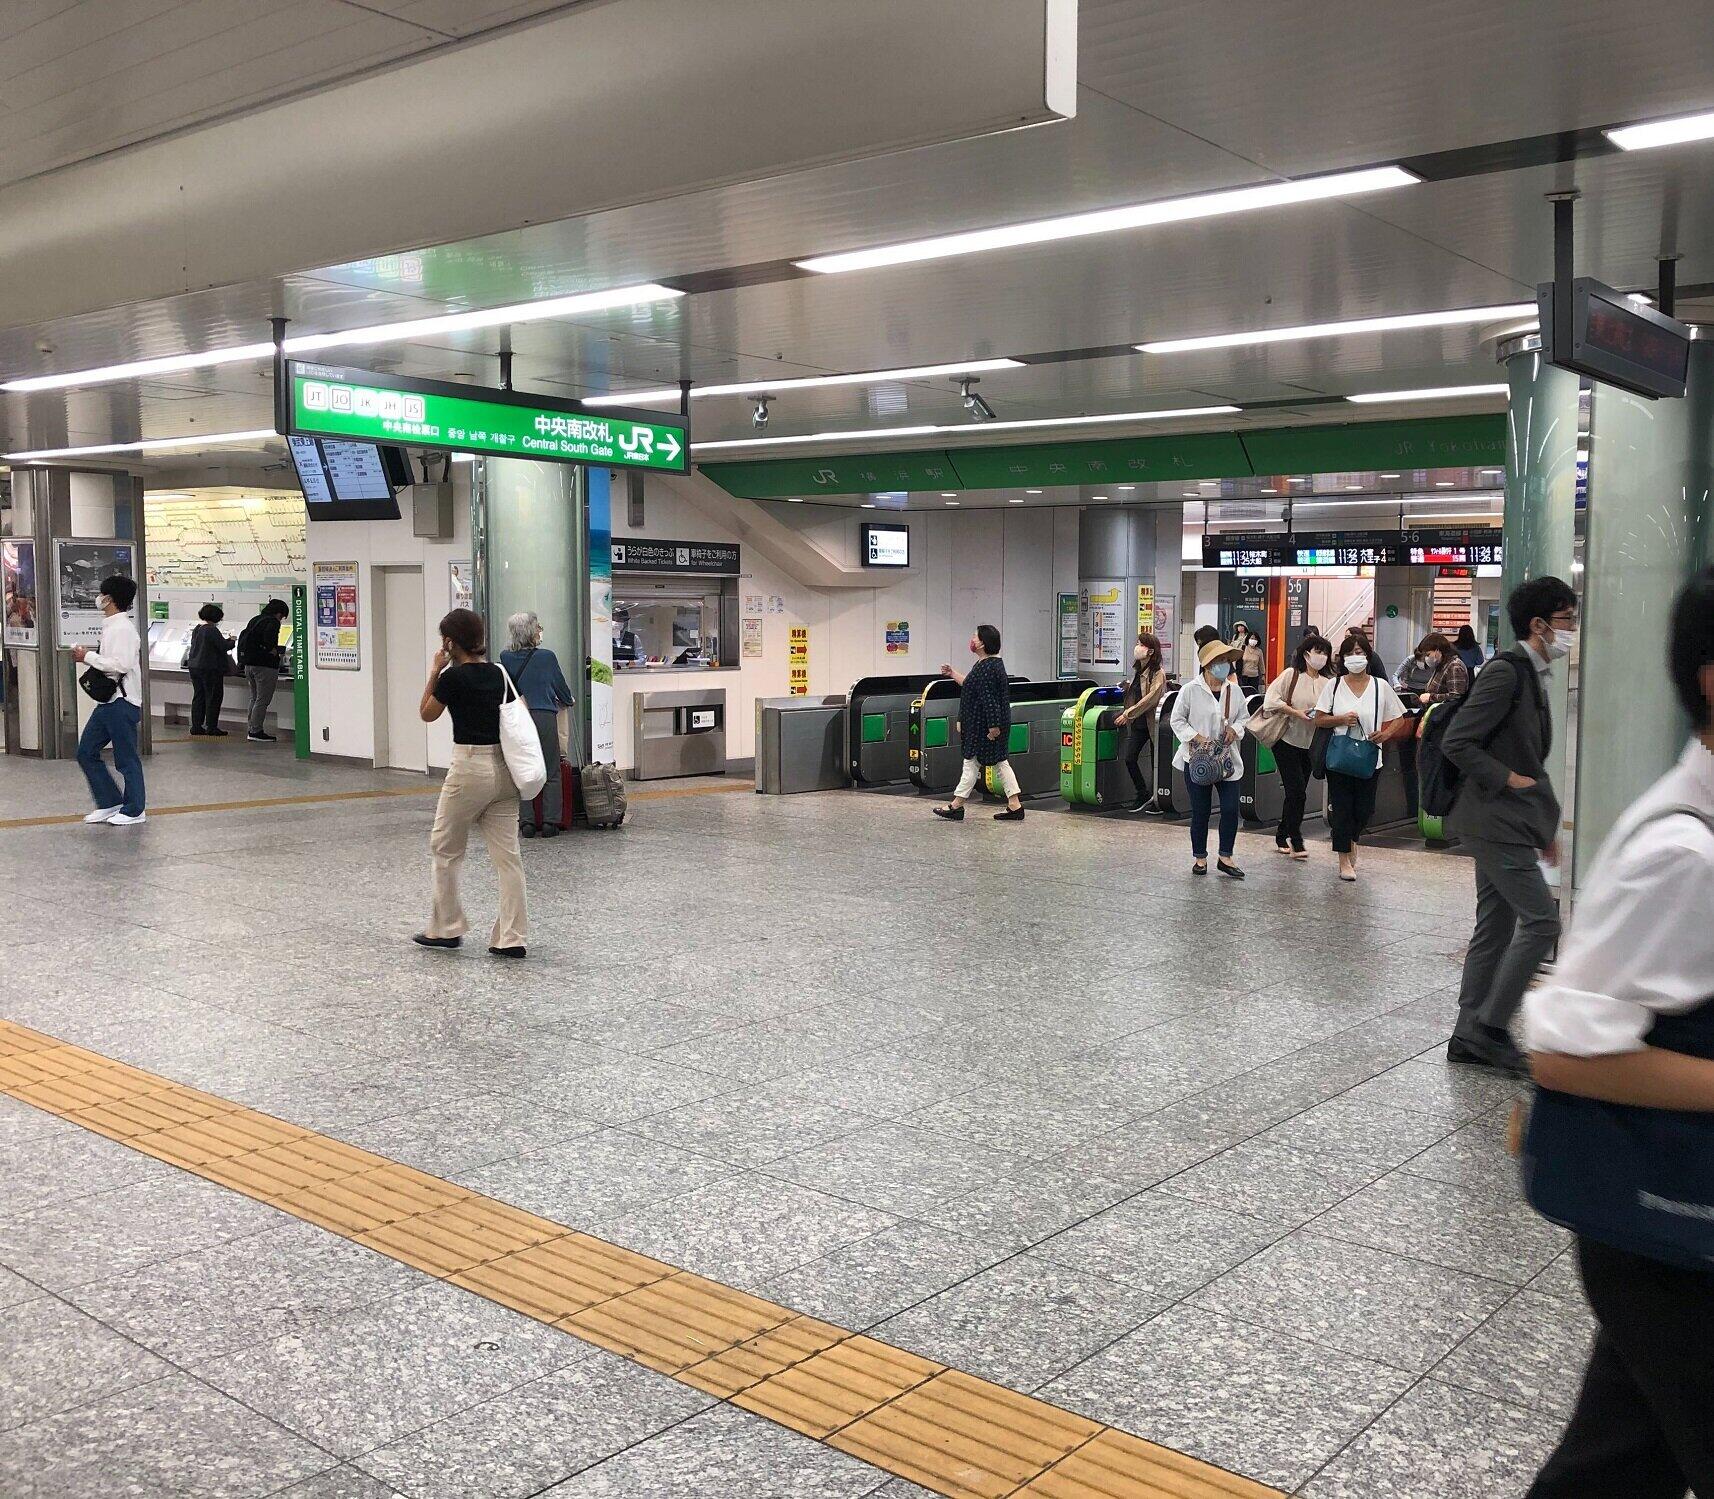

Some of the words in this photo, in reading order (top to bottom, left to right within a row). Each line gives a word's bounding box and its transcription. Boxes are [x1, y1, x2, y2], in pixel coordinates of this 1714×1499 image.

[534, 414, 614, 443] 中央南改札
[619, 426, 653, 453] JR
[522, 435, 558, 450] Central
[560, 441, 588, 455] South
[590, 443, 614, 457] Gate
[813, 468, 840, 485] JR
[1204, 535, 1211, 547] 3
[1288, 533, 1296, 545] 4
[1338, 548, 1358, 557] 11:22
[1469, 546, 1491, 555] 11:24
[1360, 556, 1381, 564] 八王子
[1380, 556, 1386, 564] 4
[1470, 554, 1491, 563] 11:26
[295, 599, 303, 633] DIGITAL
[296, 634, 304, 680] TIMETABLE
[1063, 734, 1073, 746] IC
